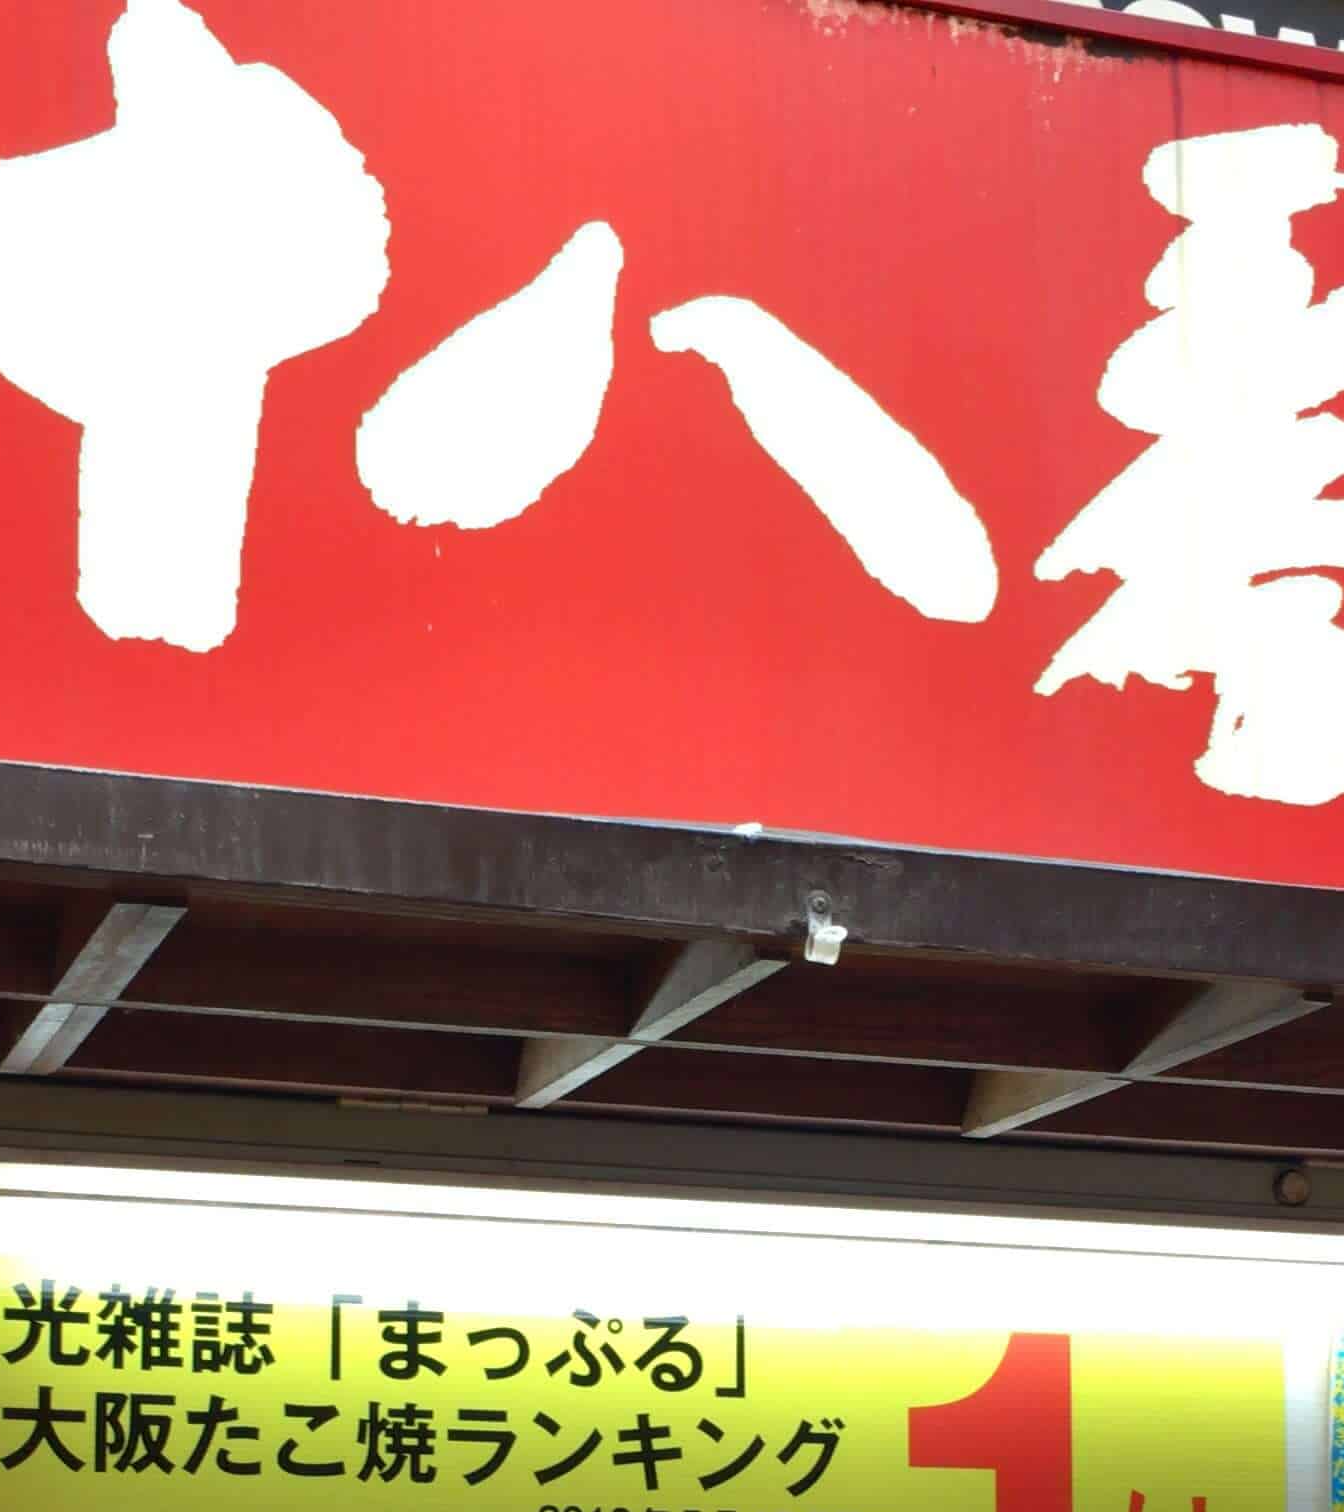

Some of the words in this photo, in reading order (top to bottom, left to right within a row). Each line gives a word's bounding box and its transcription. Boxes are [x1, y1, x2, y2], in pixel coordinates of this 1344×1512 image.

[0, 1392, 846, 1496] 大阪たこ焼ランキング
